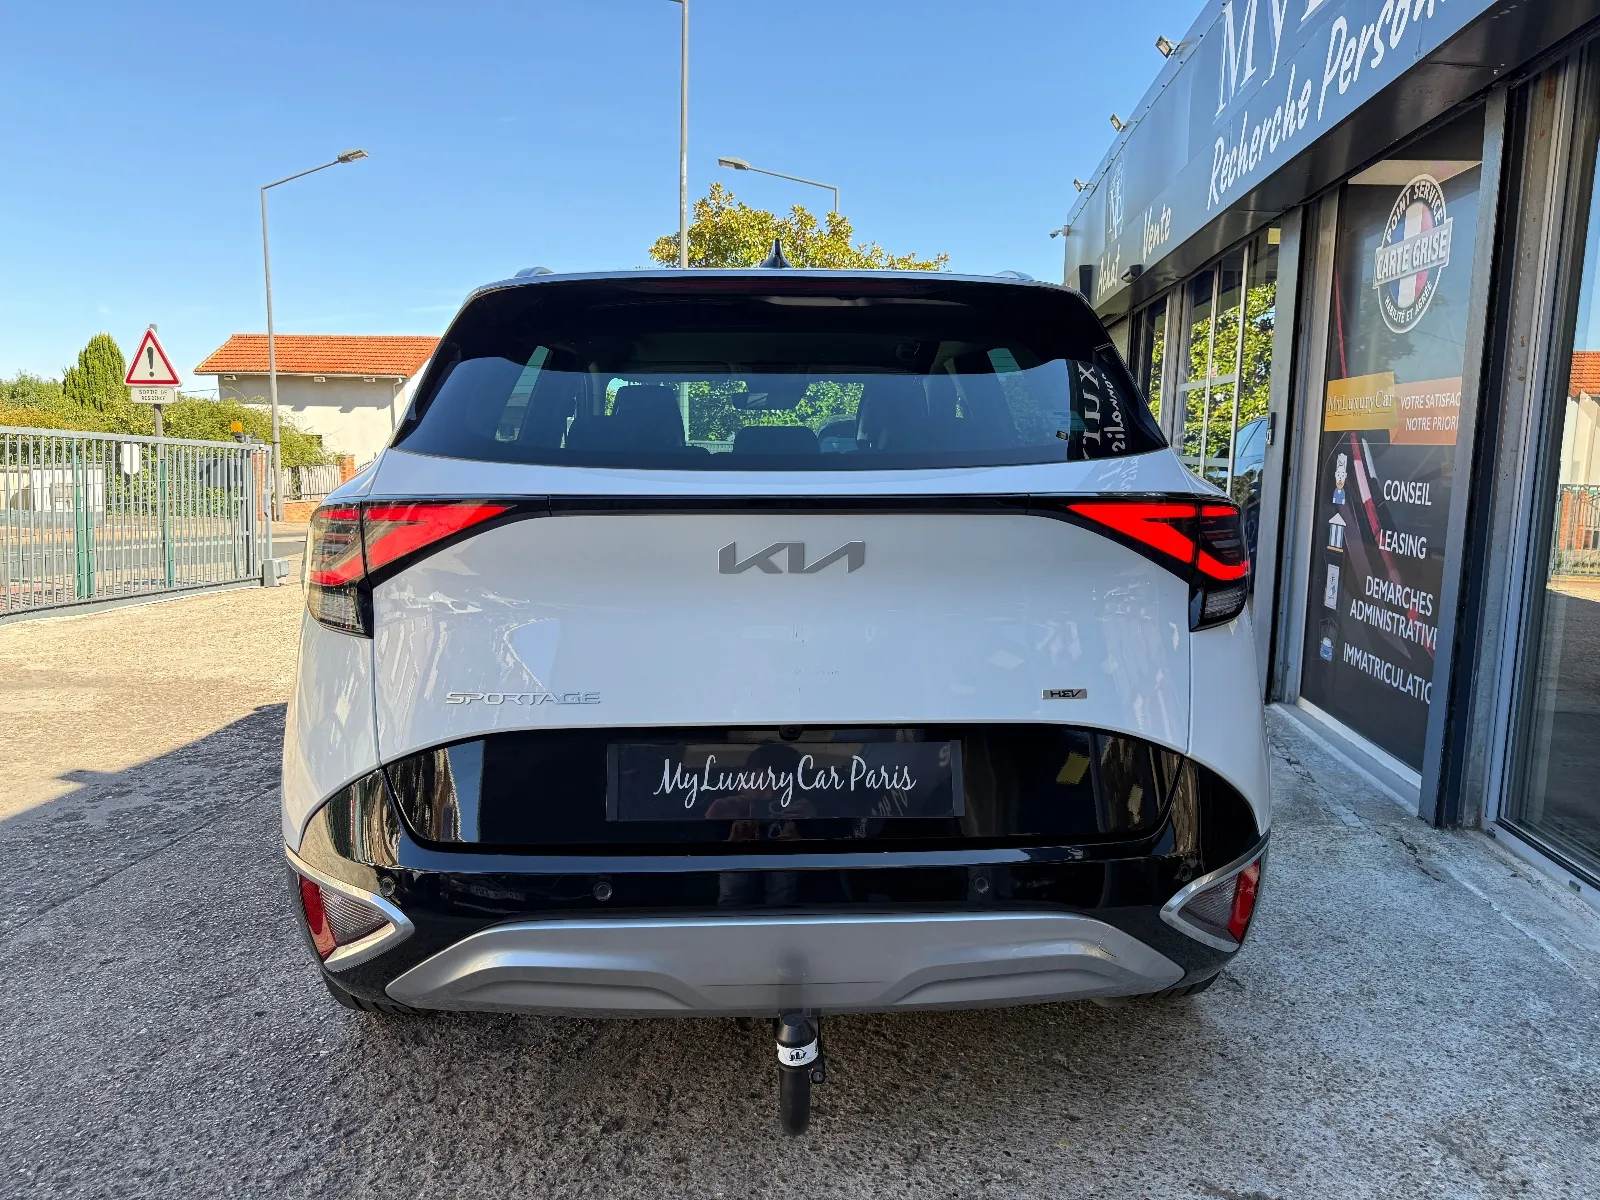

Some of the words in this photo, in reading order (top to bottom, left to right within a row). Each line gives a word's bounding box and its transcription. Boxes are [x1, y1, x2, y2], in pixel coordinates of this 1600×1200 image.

[1213, 0, 1325, 117] My
[1207, 64, 1312, 210] Recherche
[1386, 189, 1410, 243] POINT
[1413, 180, 1444, 227] SERVICE
[1143, 204, 1172, 262] Vente
[1376, 244, 1411, 280] CARTE
[1412, 228, 1449, 266] GRISE
[1096, 244, 1121, 300] Achat
[1406, 308, 1414, 323] ET
[1327, 390, 1394, 415] MyLuxuryCar
[1400, 395, 1424, 410] VOTRE
[1405, 417, 1431, 432] NOTRE
[1383, 479, 1432, 506] CONSEIL
[717, 540, 866, 574] KIA
[1378, 528, 1427, 560] LEASING
[1366, 575, 1434, 617] DEMARCHES
[446, 691, 601, 706] SPORTAGE
[1050, 689, 1082, 698] HEV
[850, 754, 917, 792] Paris
